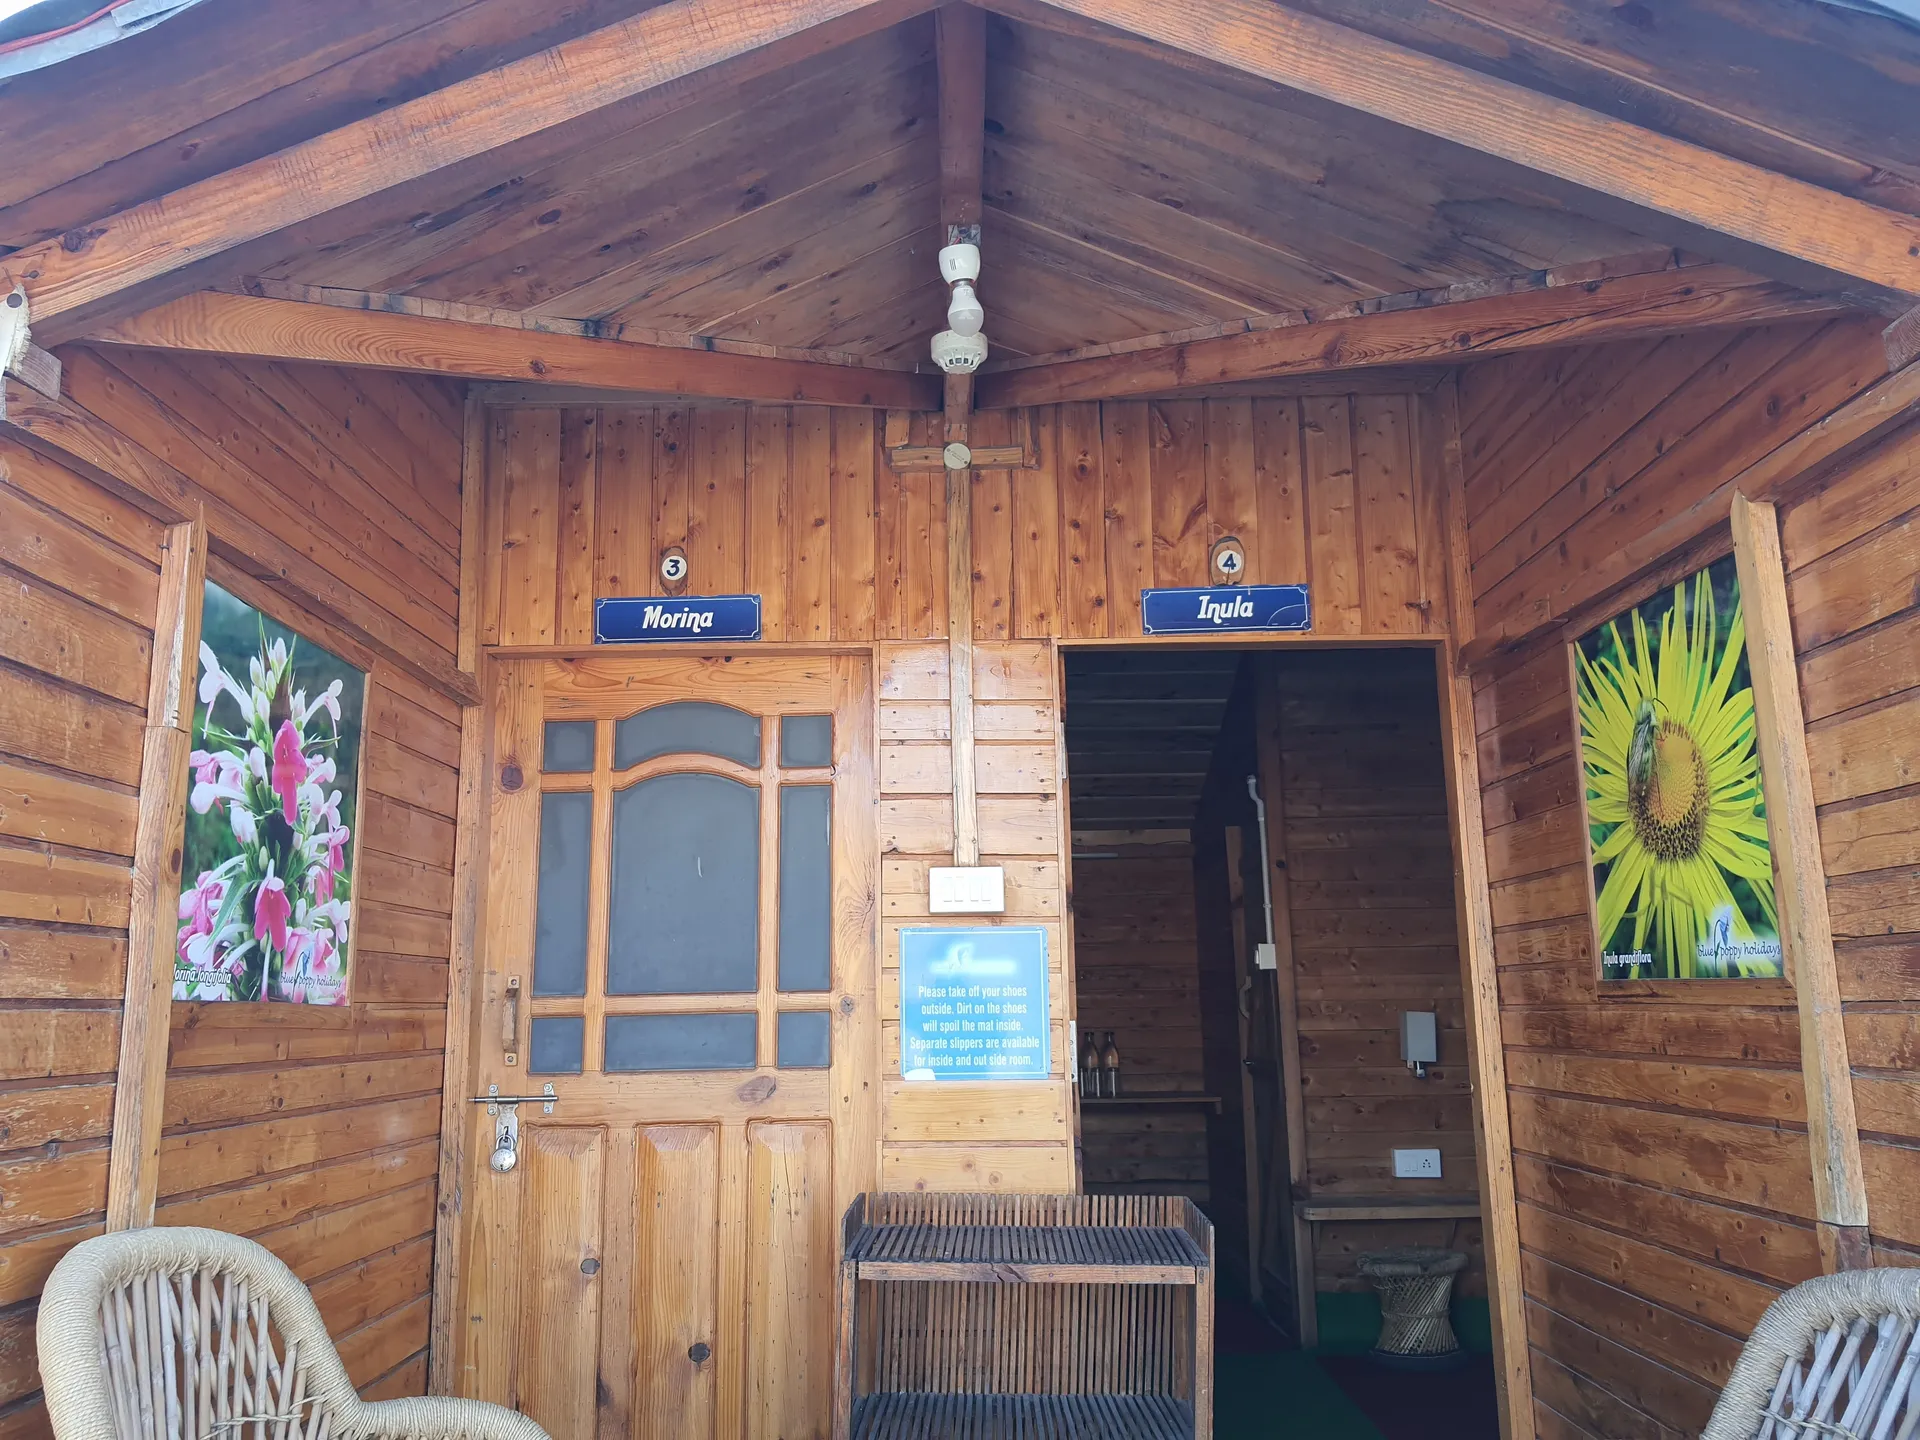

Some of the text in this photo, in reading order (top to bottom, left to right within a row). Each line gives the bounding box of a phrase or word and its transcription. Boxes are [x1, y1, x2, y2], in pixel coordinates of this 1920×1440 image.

[666, 559, 680, 577] 3
[1222, 553, 1237, 570] 4
[1197, 595, 1254, 624] Inula
[642, 605, 714, 633] Morina
[1603, 949, 1652, 968] Inula grandiflora
[1697, 941, 1781, 960] blue poppy holidays
[173, 963, 231, 987] orina longifolia
[280, 971, 294, 984] blue
[918, 985, 1027, 999] Please take off your shoes
[921, 1002, 1027, 1015] outside. Dirt on the shoes
[922, 1019, 1024, 1033] will spoil the mat inside.
[910, 1036, 1040, 1051] Separate slippers are available
[914, 1053, 1034, 1066] for inside and out side room.
